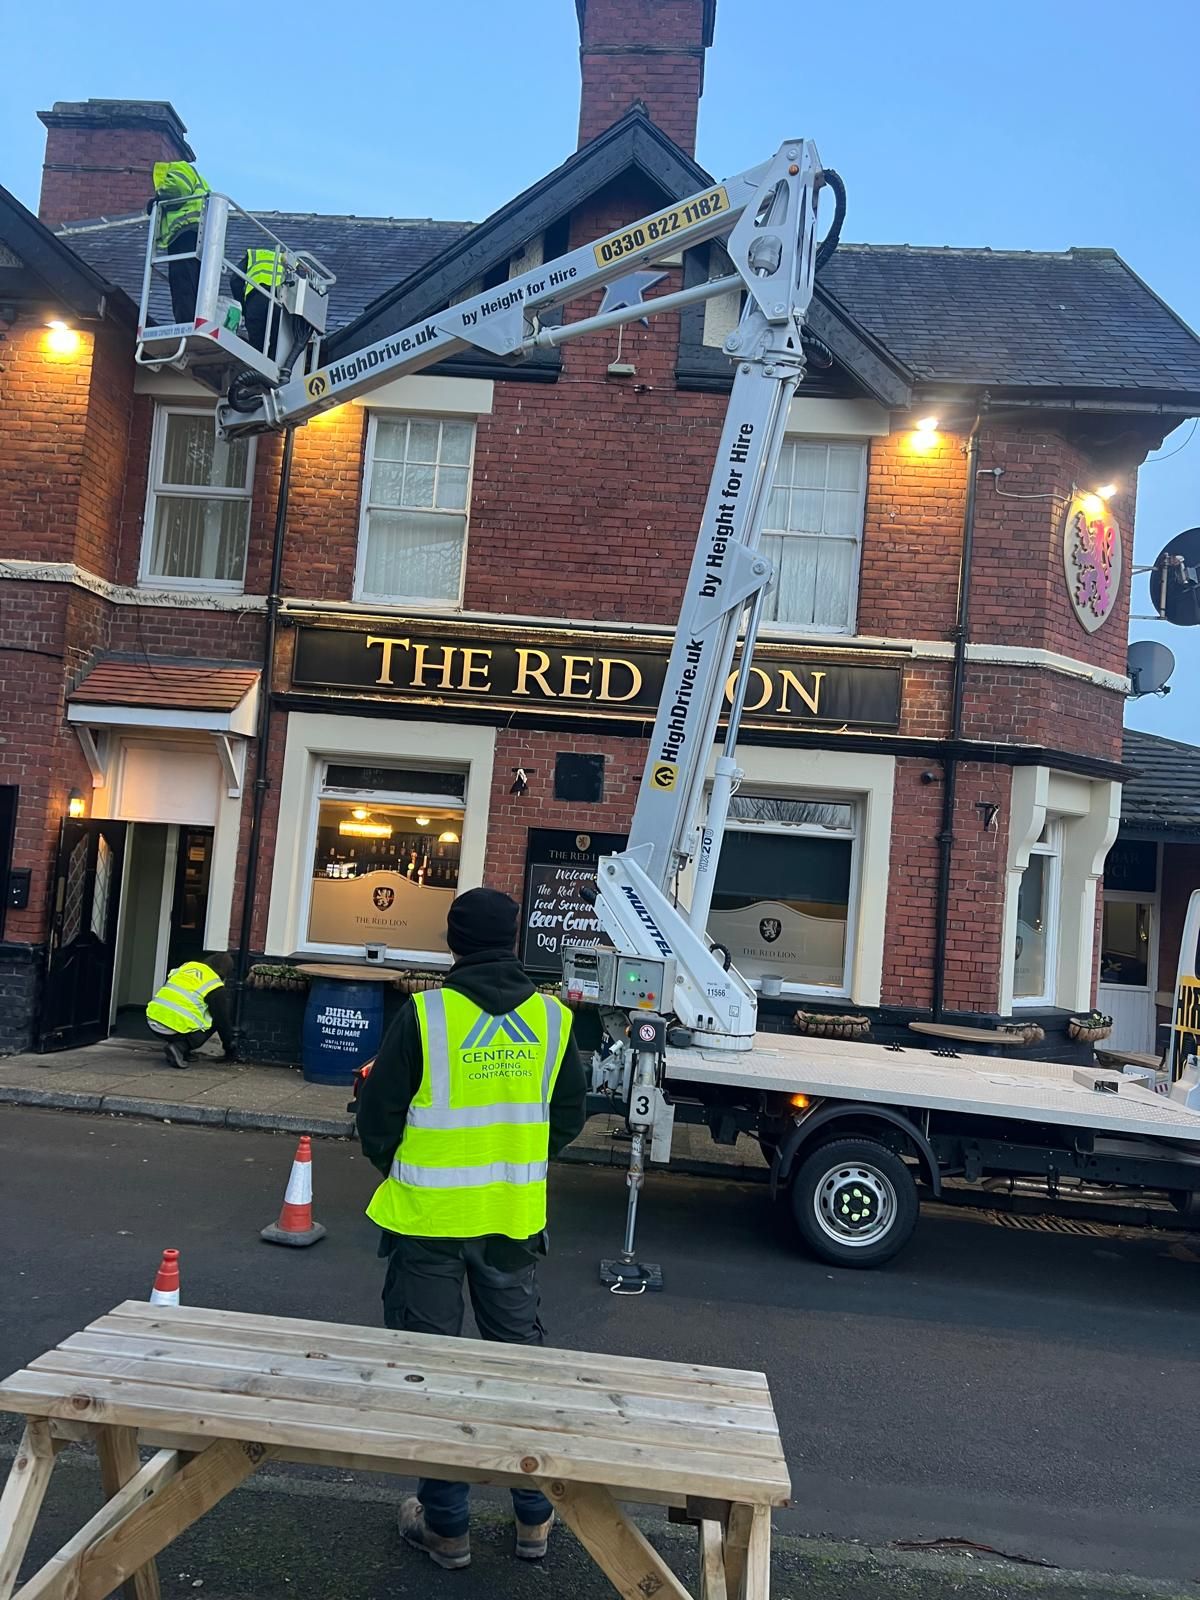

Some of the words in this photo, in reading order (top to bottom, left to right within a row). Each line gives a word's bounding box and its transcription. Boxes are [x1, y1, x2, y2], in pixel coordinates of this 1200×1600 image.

[601, 229, 645, 261] 0330
[647, 212, 681, 240] 822
[682, 193, 723, 223] 1182
[462, 310, 479, 326] by
[481, 288, 525, 317] Height
[526, 278, 546, 296] for
[549, 265, 578, 285] Hire
[329, 324, 439, 386] HighDrive.uk
[729, 423, 754, 463] Hire
[722, 469, 743, 498] for
[706, 504, 736, 568] Height
[699, 573, 722, 598] by
[366, 635, 492, 692] THE
[511, 648, 643, 701] RED
[660, 638, 705, 763] HighDrive.uk
[548, 849, 567, 860] THE
[570, 851, 590, 861] RED
[555, 869, 597, 881] Welcom
[537, 884, 551, 896] The
[557, 885, 575, 897] Red
[534, 899, 557, 910] Food
[356, 916, 368, 924] THE
[372, 917, 388, 925] RED
[389, 918, 408, 927] LION
[529, 911, 562, 928] Beer
[621, 885, 673, 957] MULTITEL
[537, 933, 557, 953] Dog
[325, 1006, 362, 1019] BIRRA
[316, 1015, 369, 1029] MORETTI
[321, 1026, 336, 1035] SALE
[344, 1030, 361, 1038] MARE
[462, 1049, 536, 1064] CENTRAL
[468, 1070, 533, 1080] CONTRACTORS
[481, 1062, 521, 1071] ROOFING
[635, 1095, 650, 1116] 3
